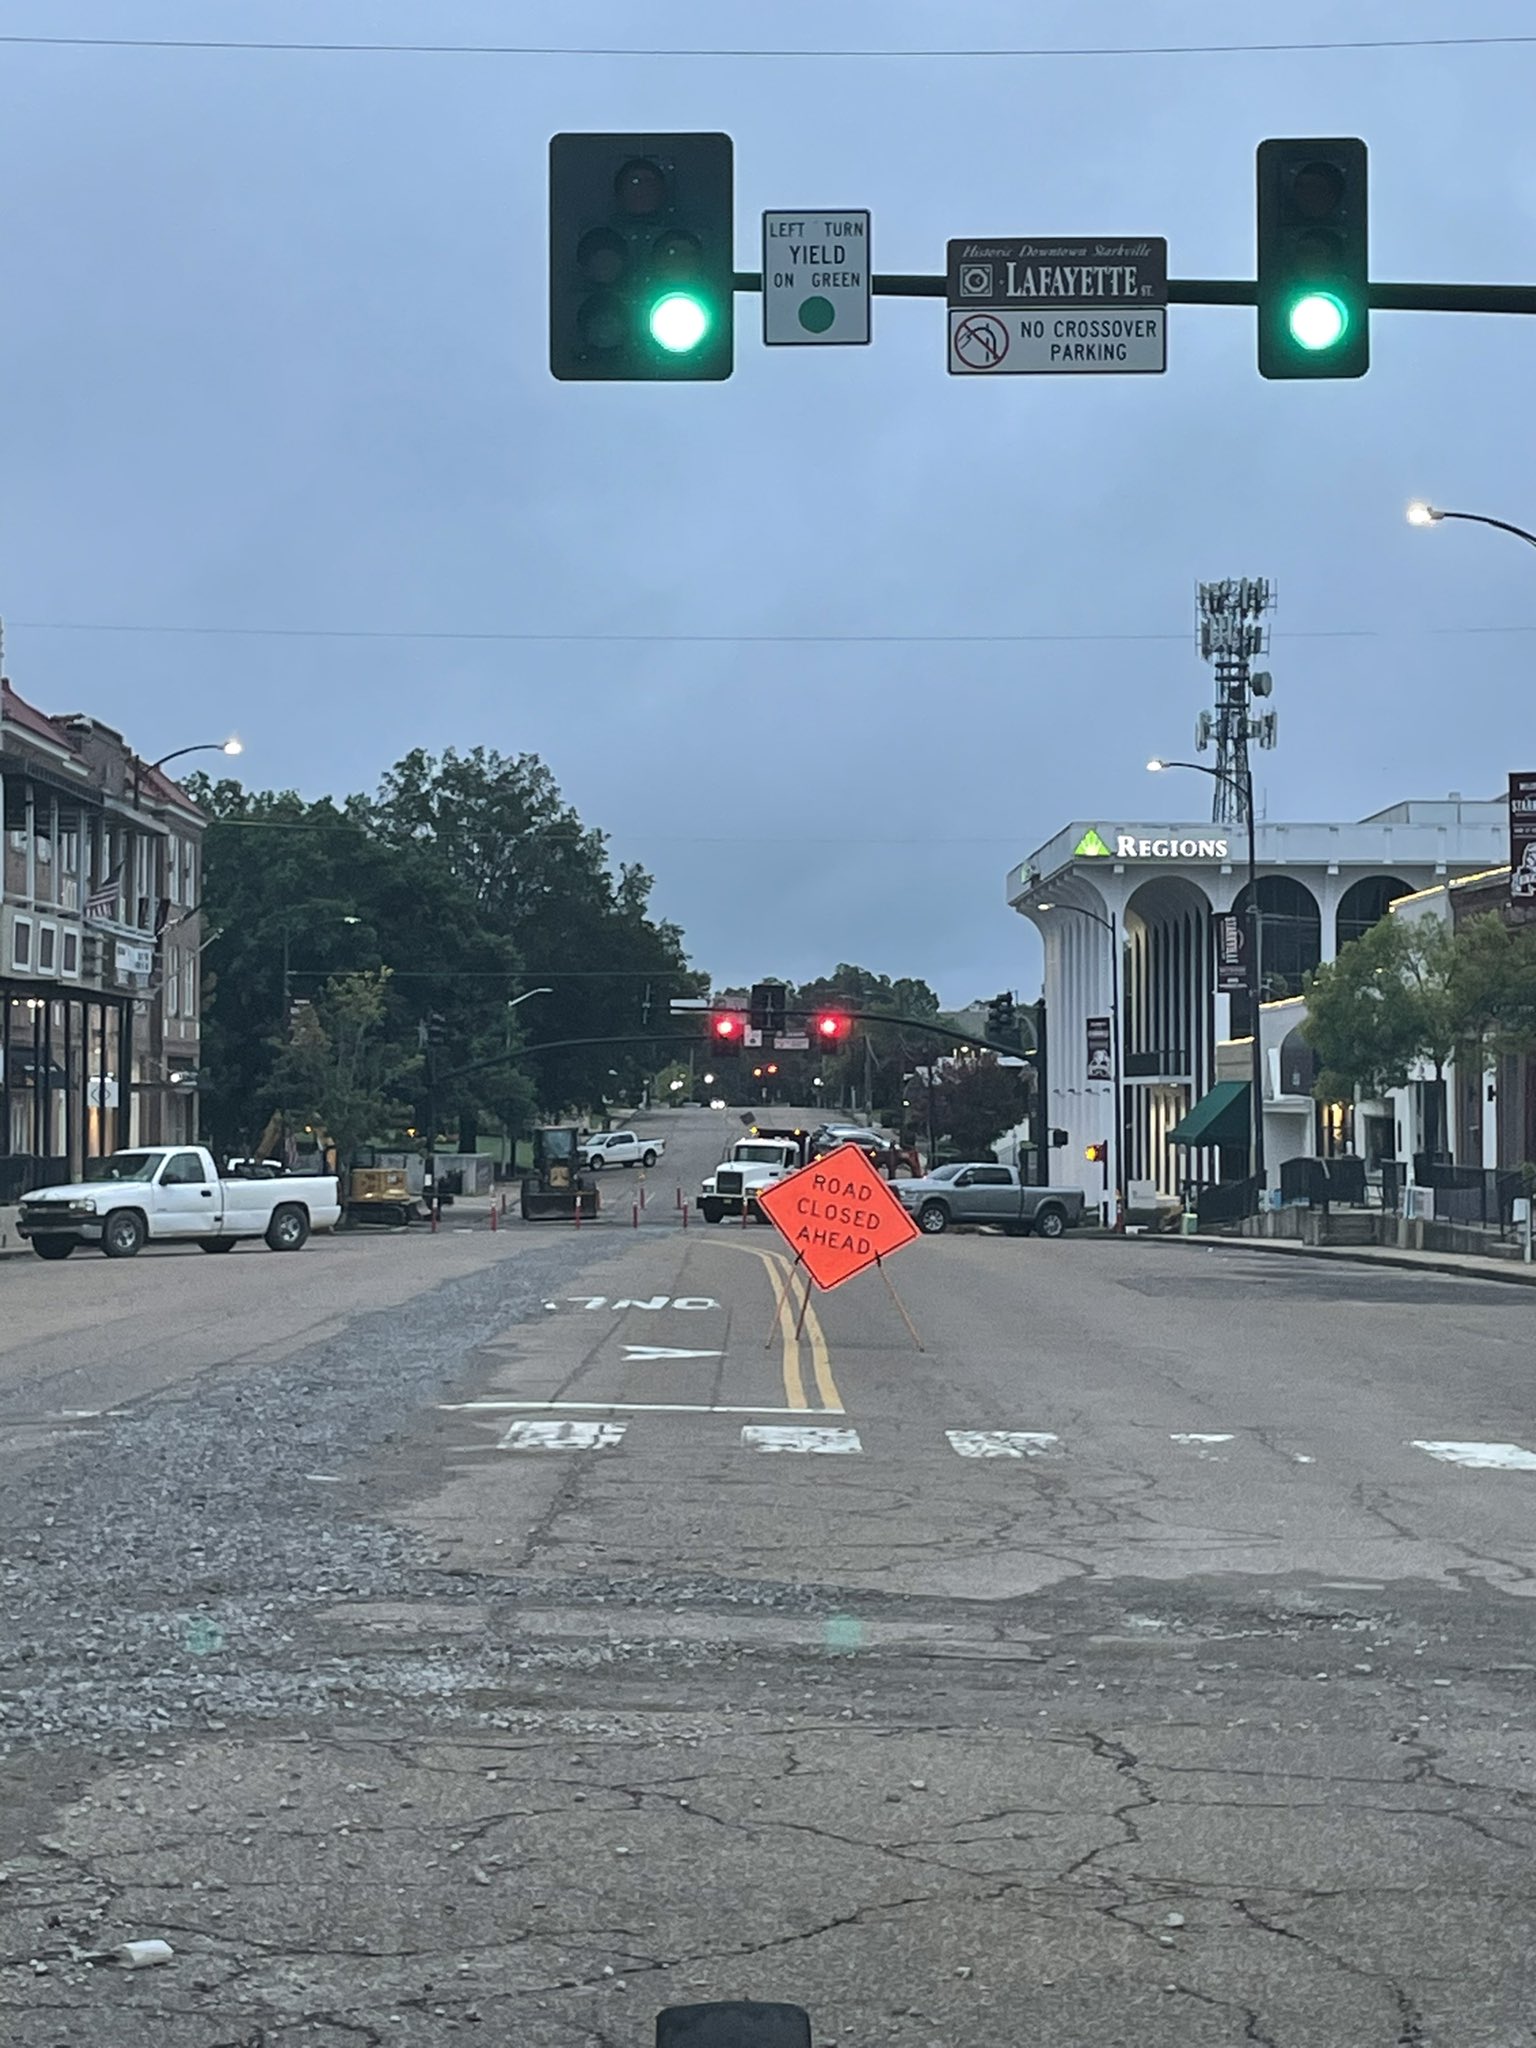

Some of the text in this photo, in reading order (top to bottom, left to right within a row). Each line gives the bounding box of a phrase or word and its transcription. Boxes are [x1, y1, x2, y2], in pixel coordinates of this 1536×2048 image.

[770, 221, 864, 238] LEFT TURN
[789, 245, 846, 264] YIELD
[962, 244, 1152, 258] Historic Downtown Starkville
[773, 272, 861, 288] ON GREEN
[1006, 262, 1138, 297] LAFAYETTE
[1020, 320, 1157, 338] NO CROSSOVER
[1050, 344, 1127, 361] PARKING
[1116, 835, 1228, 858] REGIONS
[812, 1174, 872, 1201] ROAD
[797, 1197, 880, 1230] CLOSED
[795, 1226, 870, 1255] AHEAD
